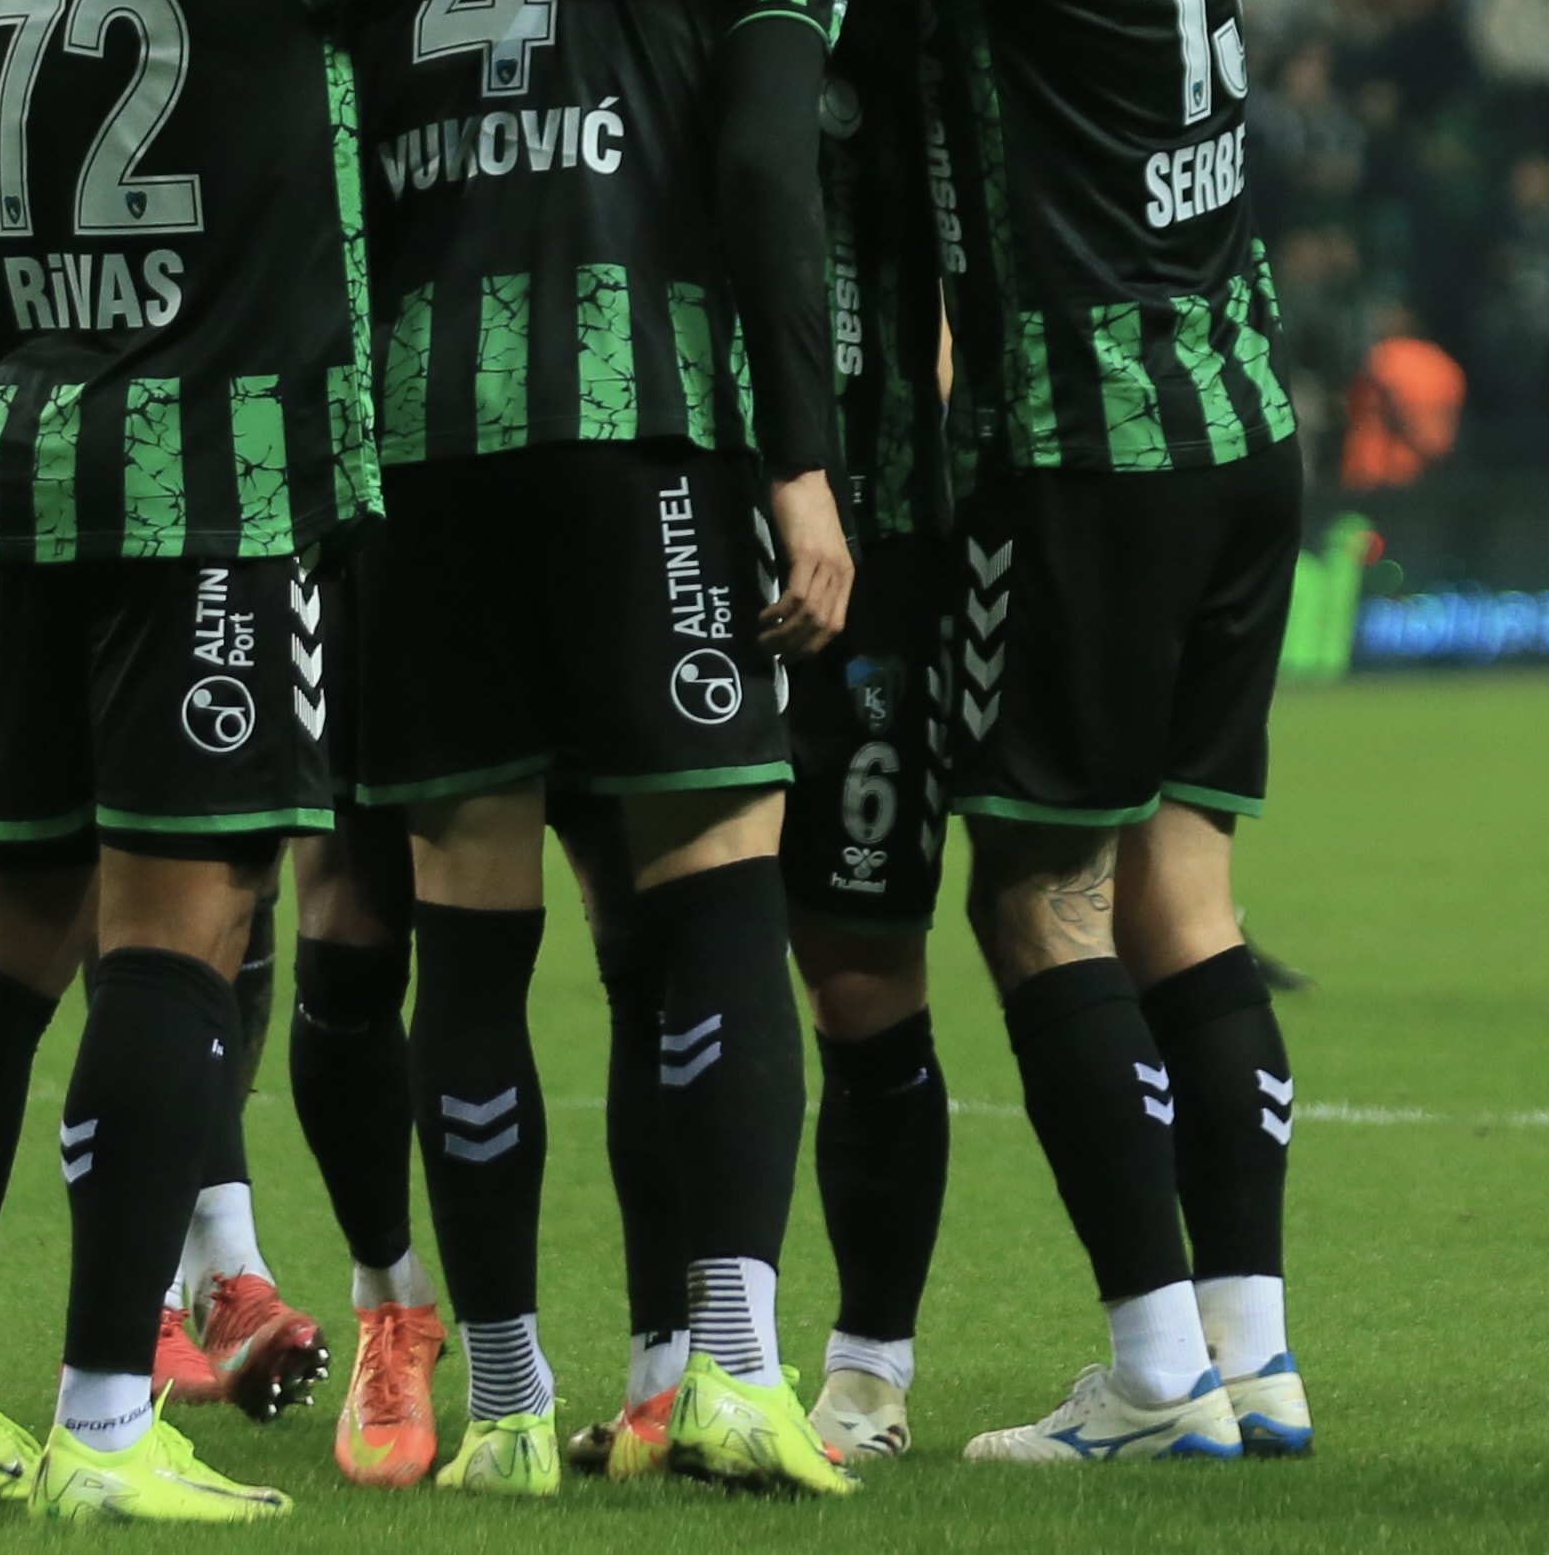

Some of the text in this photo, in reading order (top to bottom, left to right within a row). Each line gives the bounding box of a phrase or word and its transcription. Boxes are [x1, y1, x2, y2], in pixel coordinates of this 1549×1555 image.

[377, 96, 626, 202] VUKOVIĆ
[1145, 122, 1247, 229] SERBE
[658, 475, 709, 640] ALTINTEL
[193, 567, 230, 666] ALTIN
[228, 611, 255, 667] Port
[709, 584, 734, 640] Port
[841, 740, 901, 844] 6
